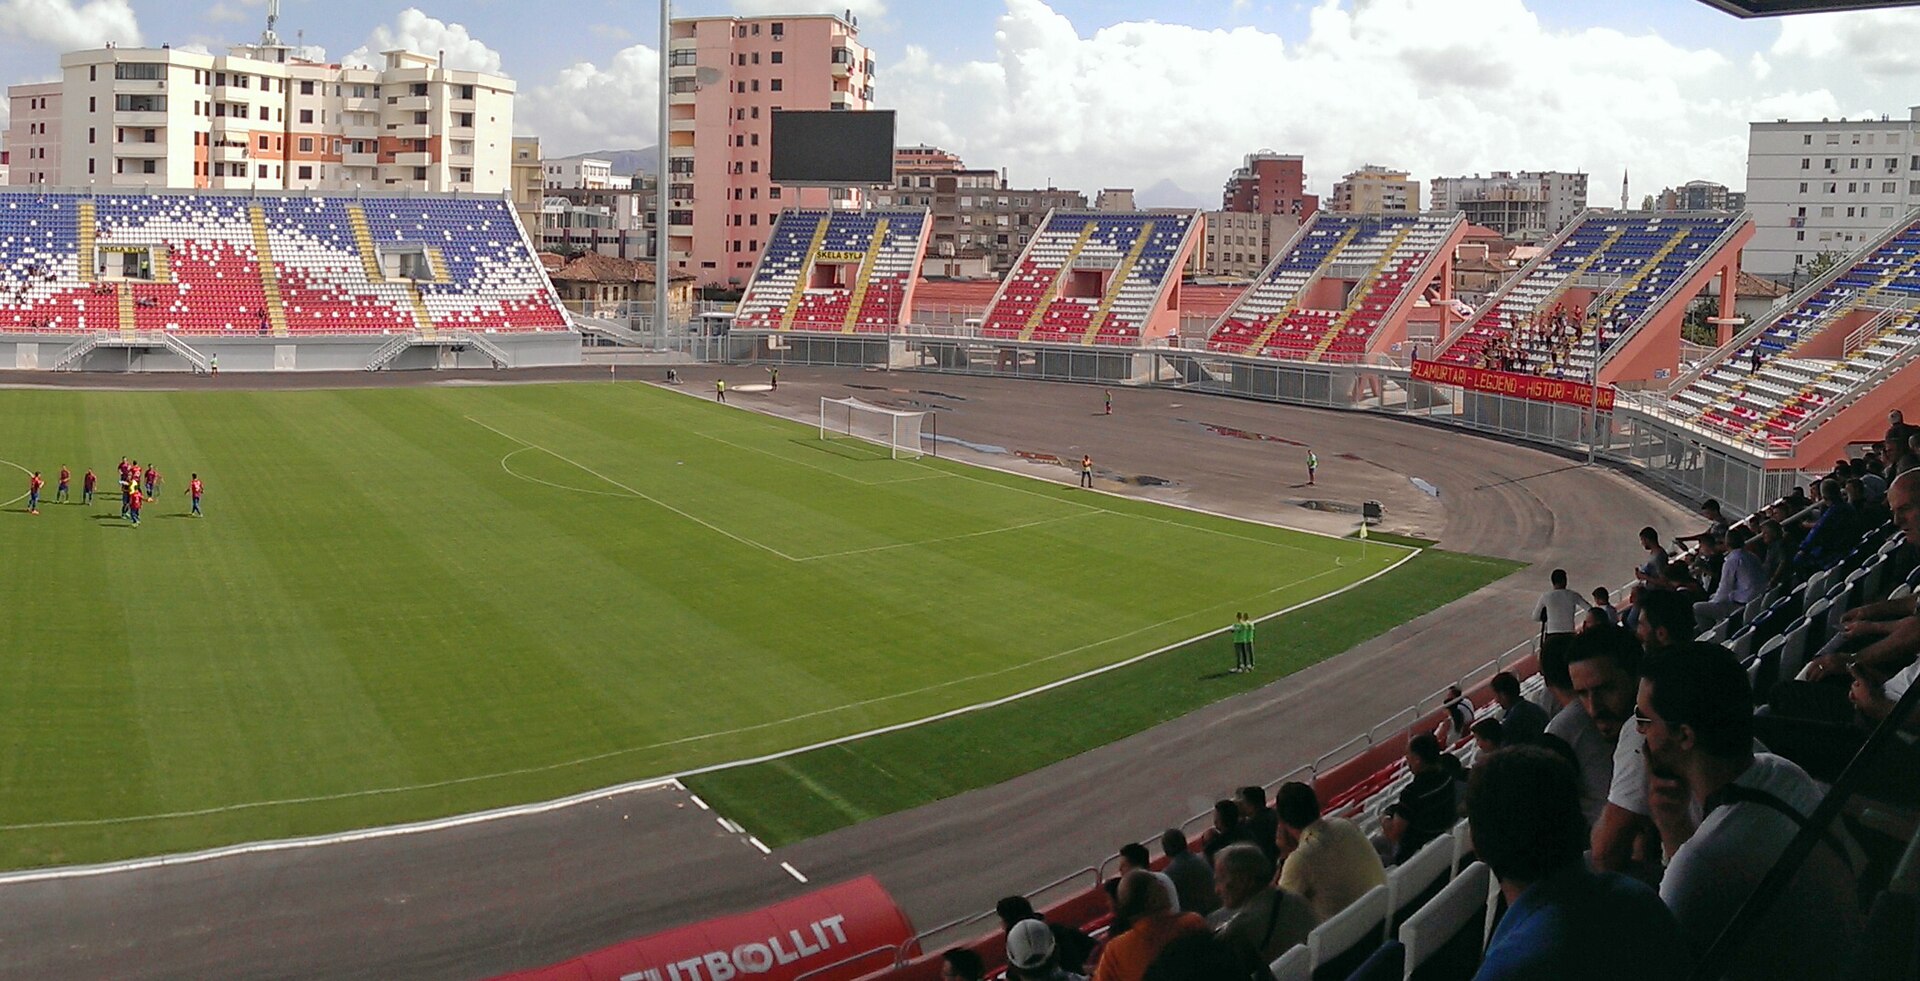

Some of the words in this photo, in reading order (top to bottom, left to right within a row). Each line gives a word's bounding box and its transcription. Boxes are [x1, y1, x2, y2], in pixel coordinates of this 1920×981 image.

[1412, 361, 1467, 384] FLAMURTARI
[1474, 373, 1516, 393] LEGJEND
[1526, 380, 1565, 399] HISTORI
[1573, 384, 1613, 408] KREARI
